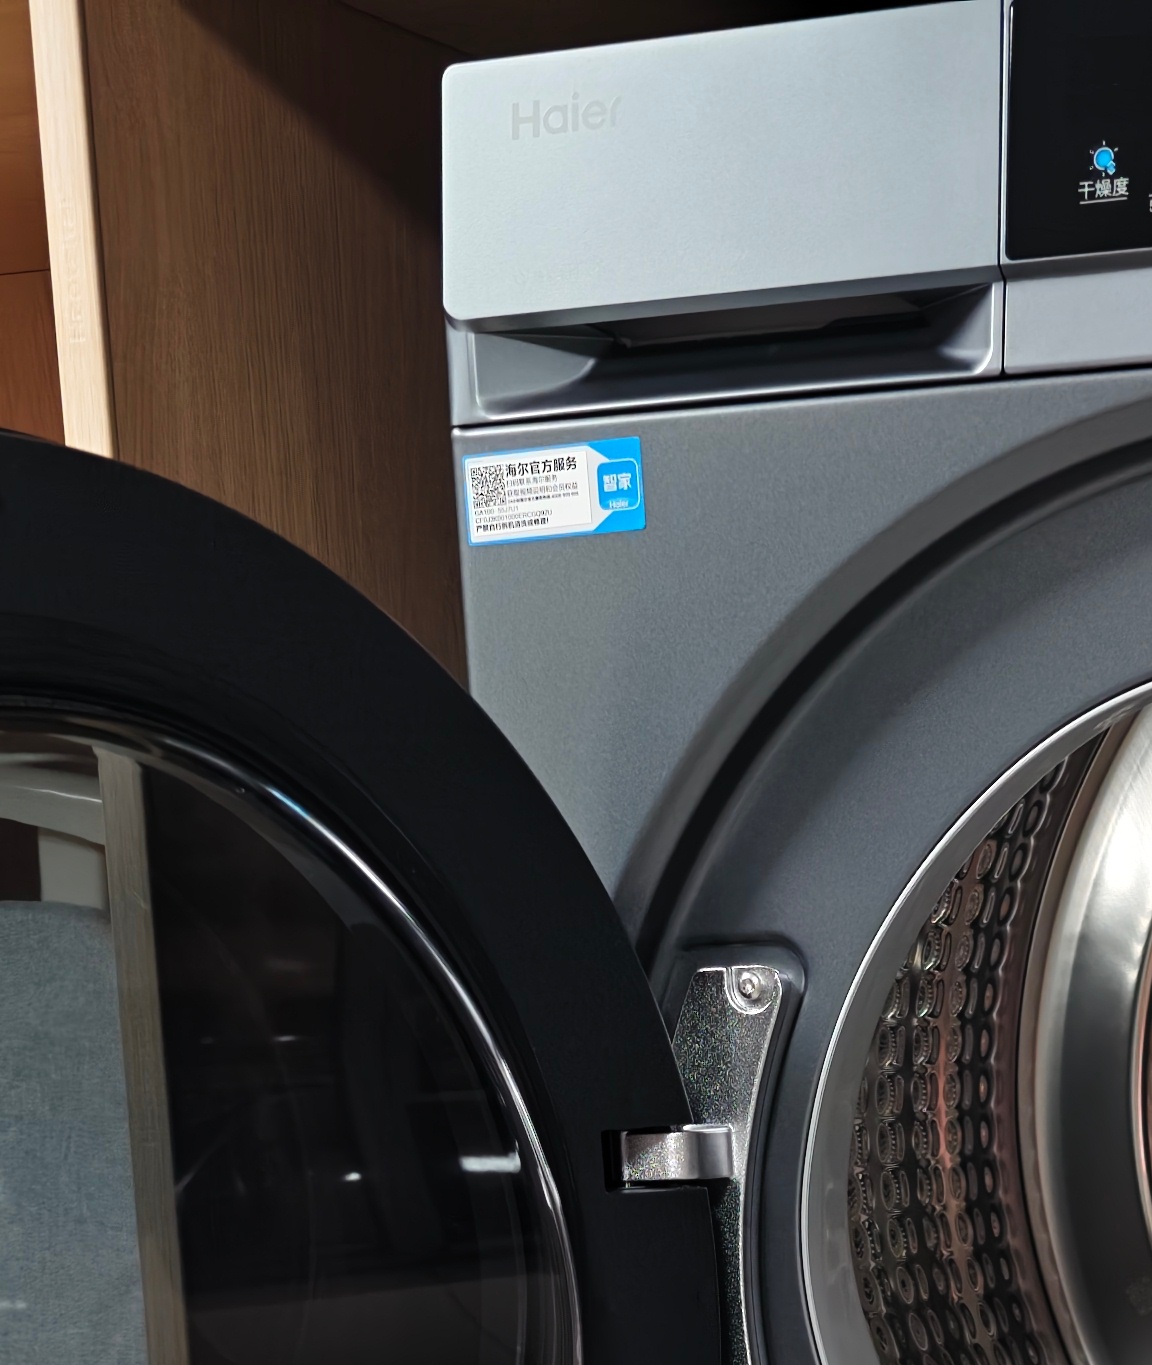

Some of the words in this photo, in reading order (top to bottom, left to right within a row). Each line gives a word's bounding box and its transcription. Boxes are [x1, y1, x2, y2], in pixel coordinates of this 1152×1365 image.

[511, 91, 622, 140] Haier
[1078, 177, 1129, 199] 干燥度
[505, 456, 577, 478] 海尔官方服务
[603, 473, 631, 492] 智家
